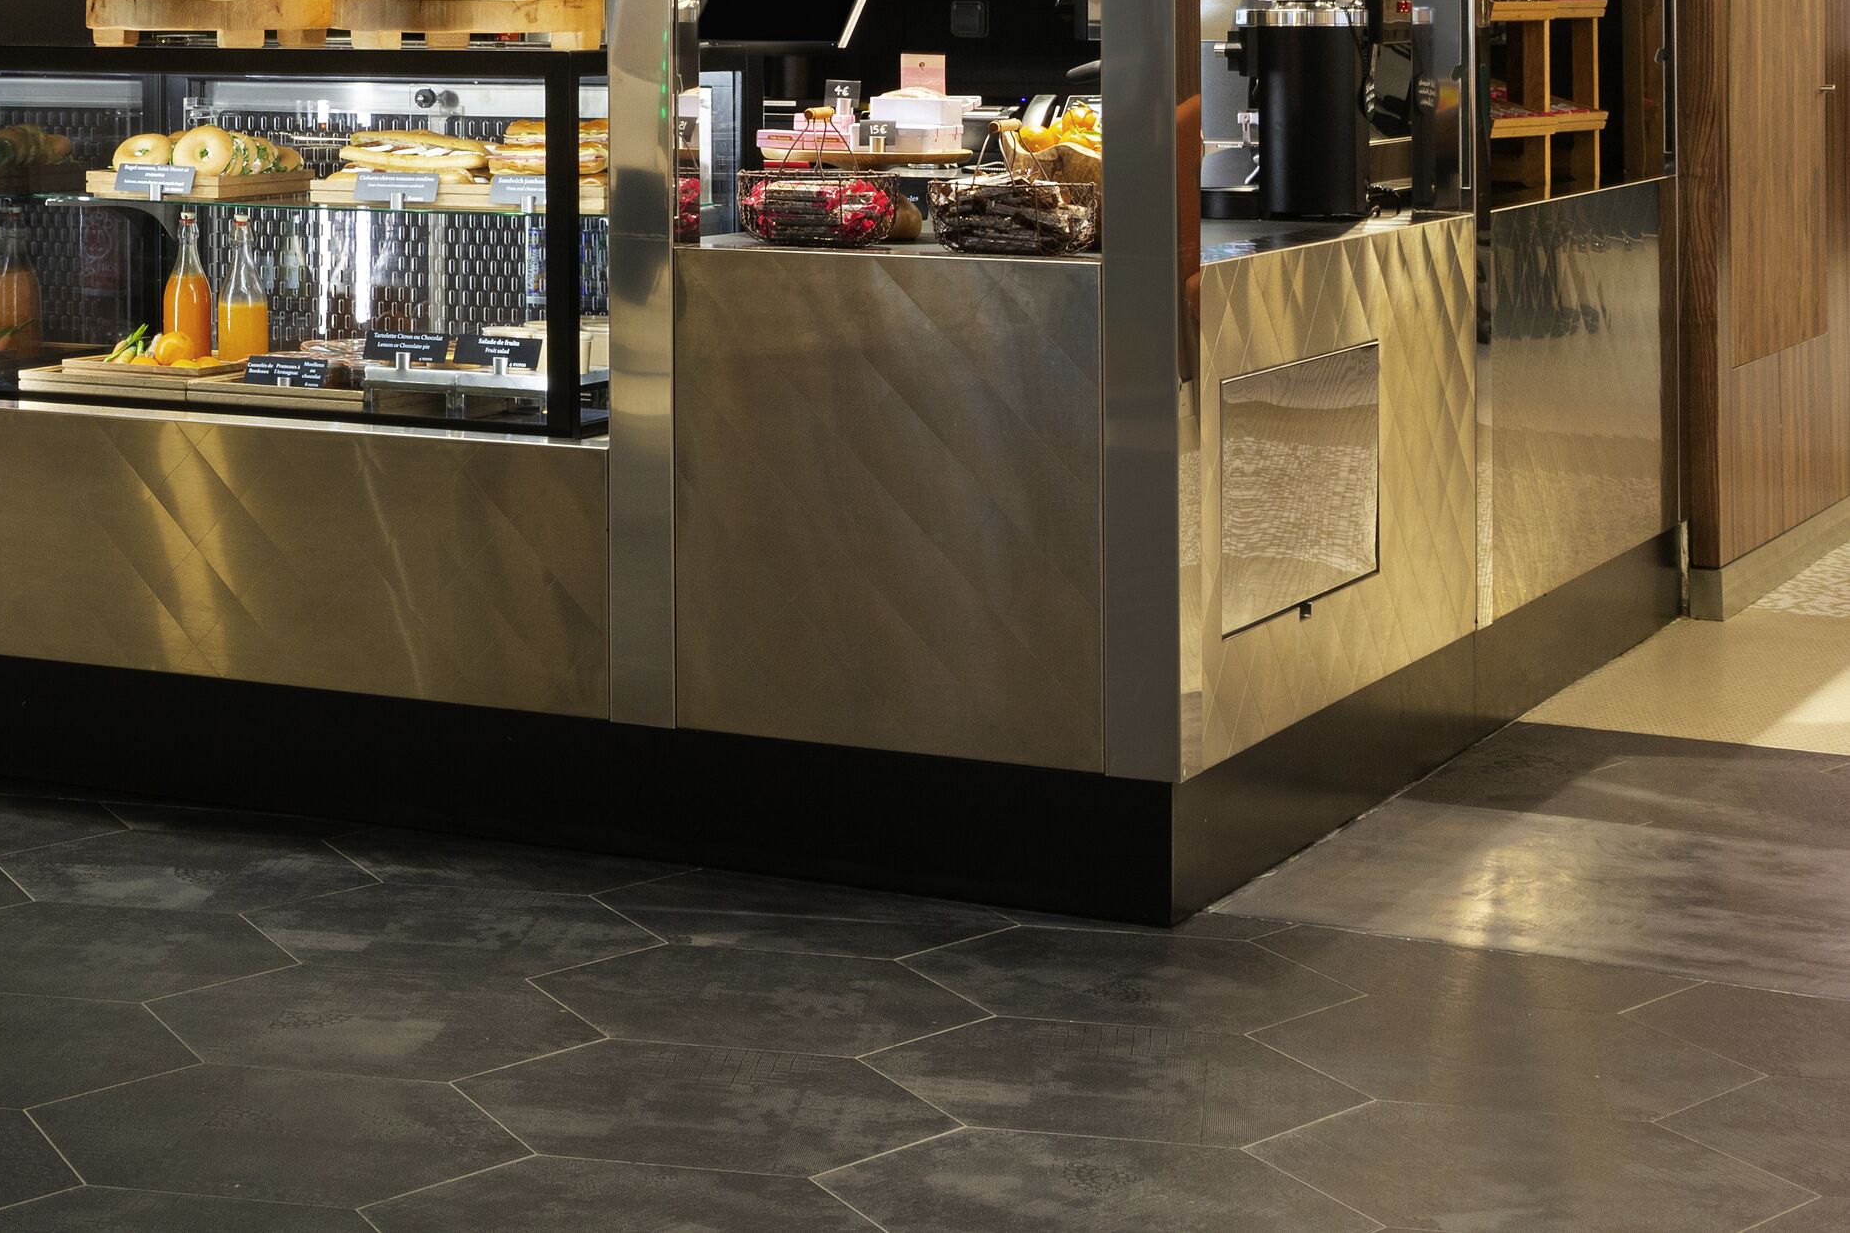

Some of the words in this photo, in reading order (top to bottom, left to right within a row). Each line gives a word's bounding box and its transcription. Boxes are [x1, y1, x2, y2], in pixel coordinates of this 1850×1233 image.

[833, 85, 850, 97] 4€
[869, 124, 888, 135] 15€
[400, 342, 422, 350] Chocolate
[497, 338, 504, 346] de
